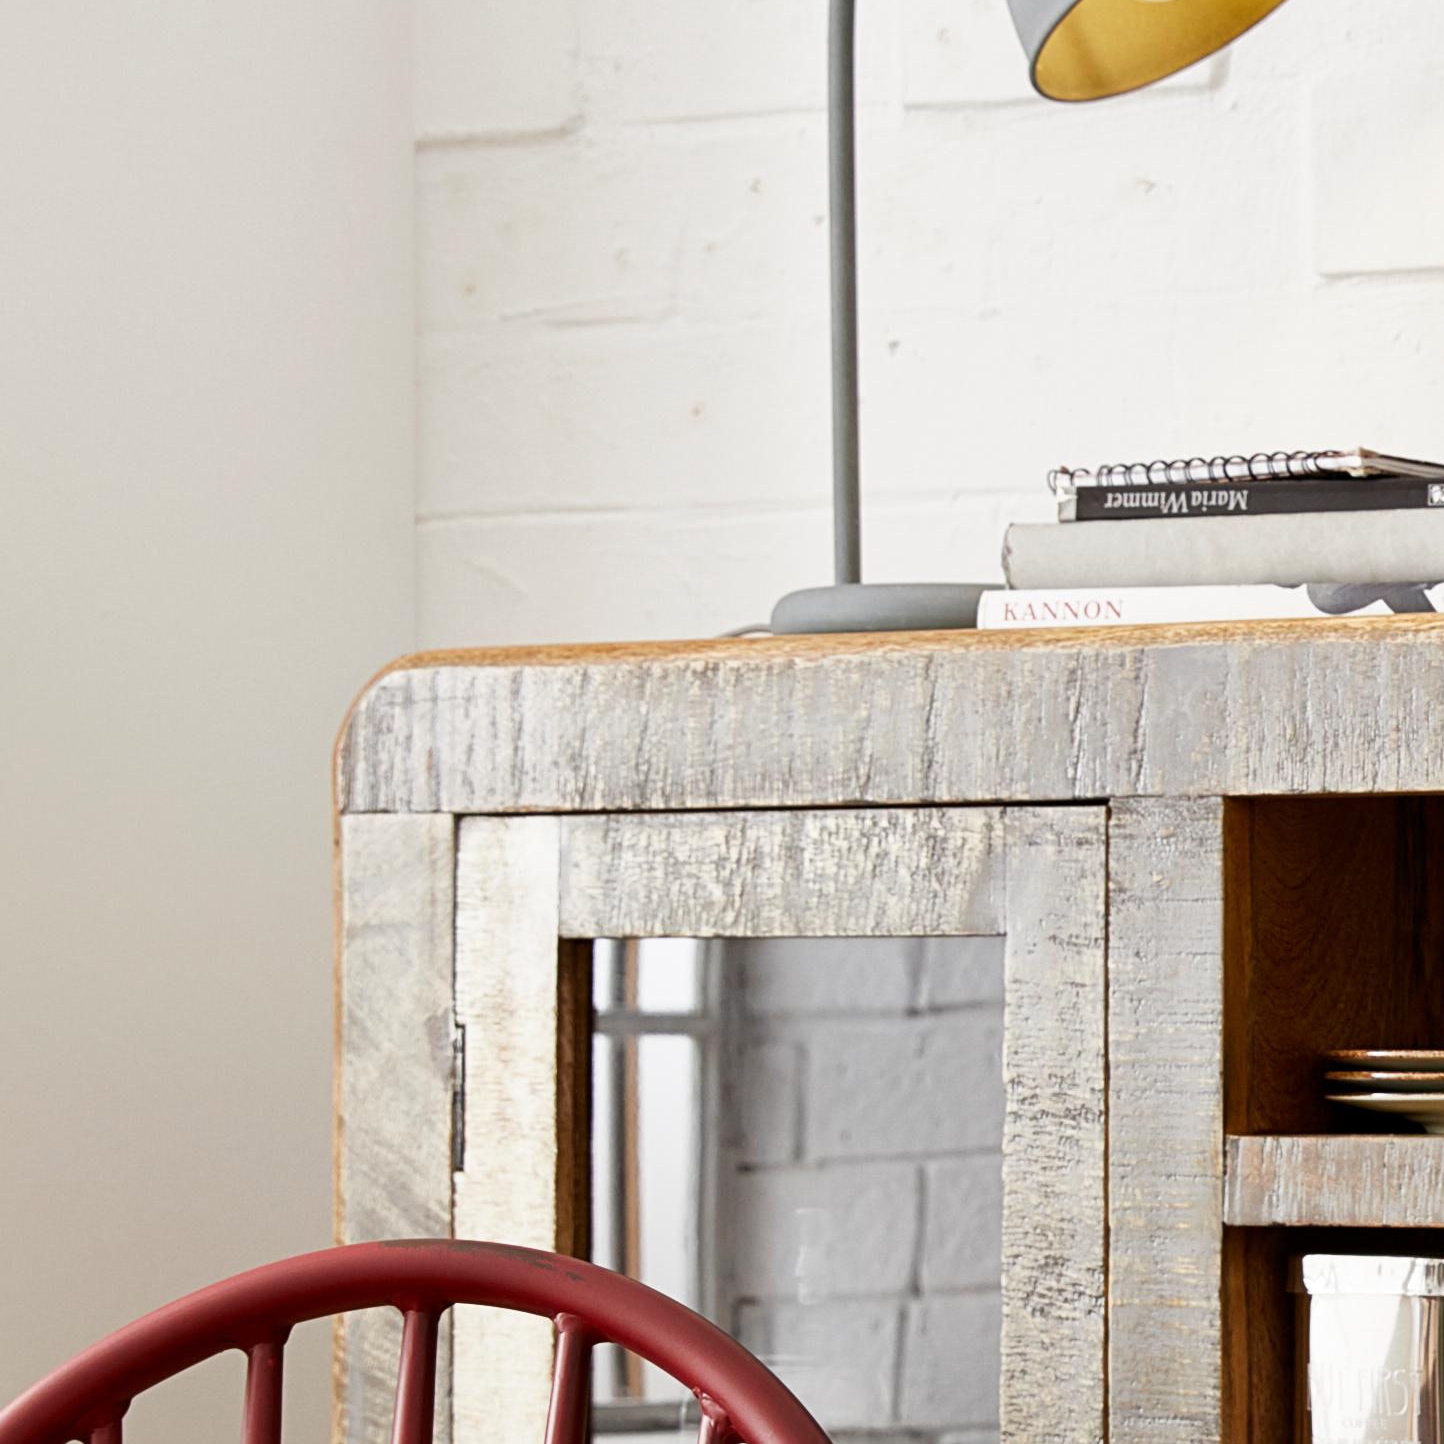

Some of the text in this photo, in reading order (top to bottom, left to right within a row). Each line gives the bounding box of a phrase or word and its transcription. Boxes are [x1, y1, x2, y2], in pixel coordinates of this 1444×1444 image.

[1104, 490, 1249, 514] Maria Wimmer
[1004, 600, 1124, 622] KANNON
